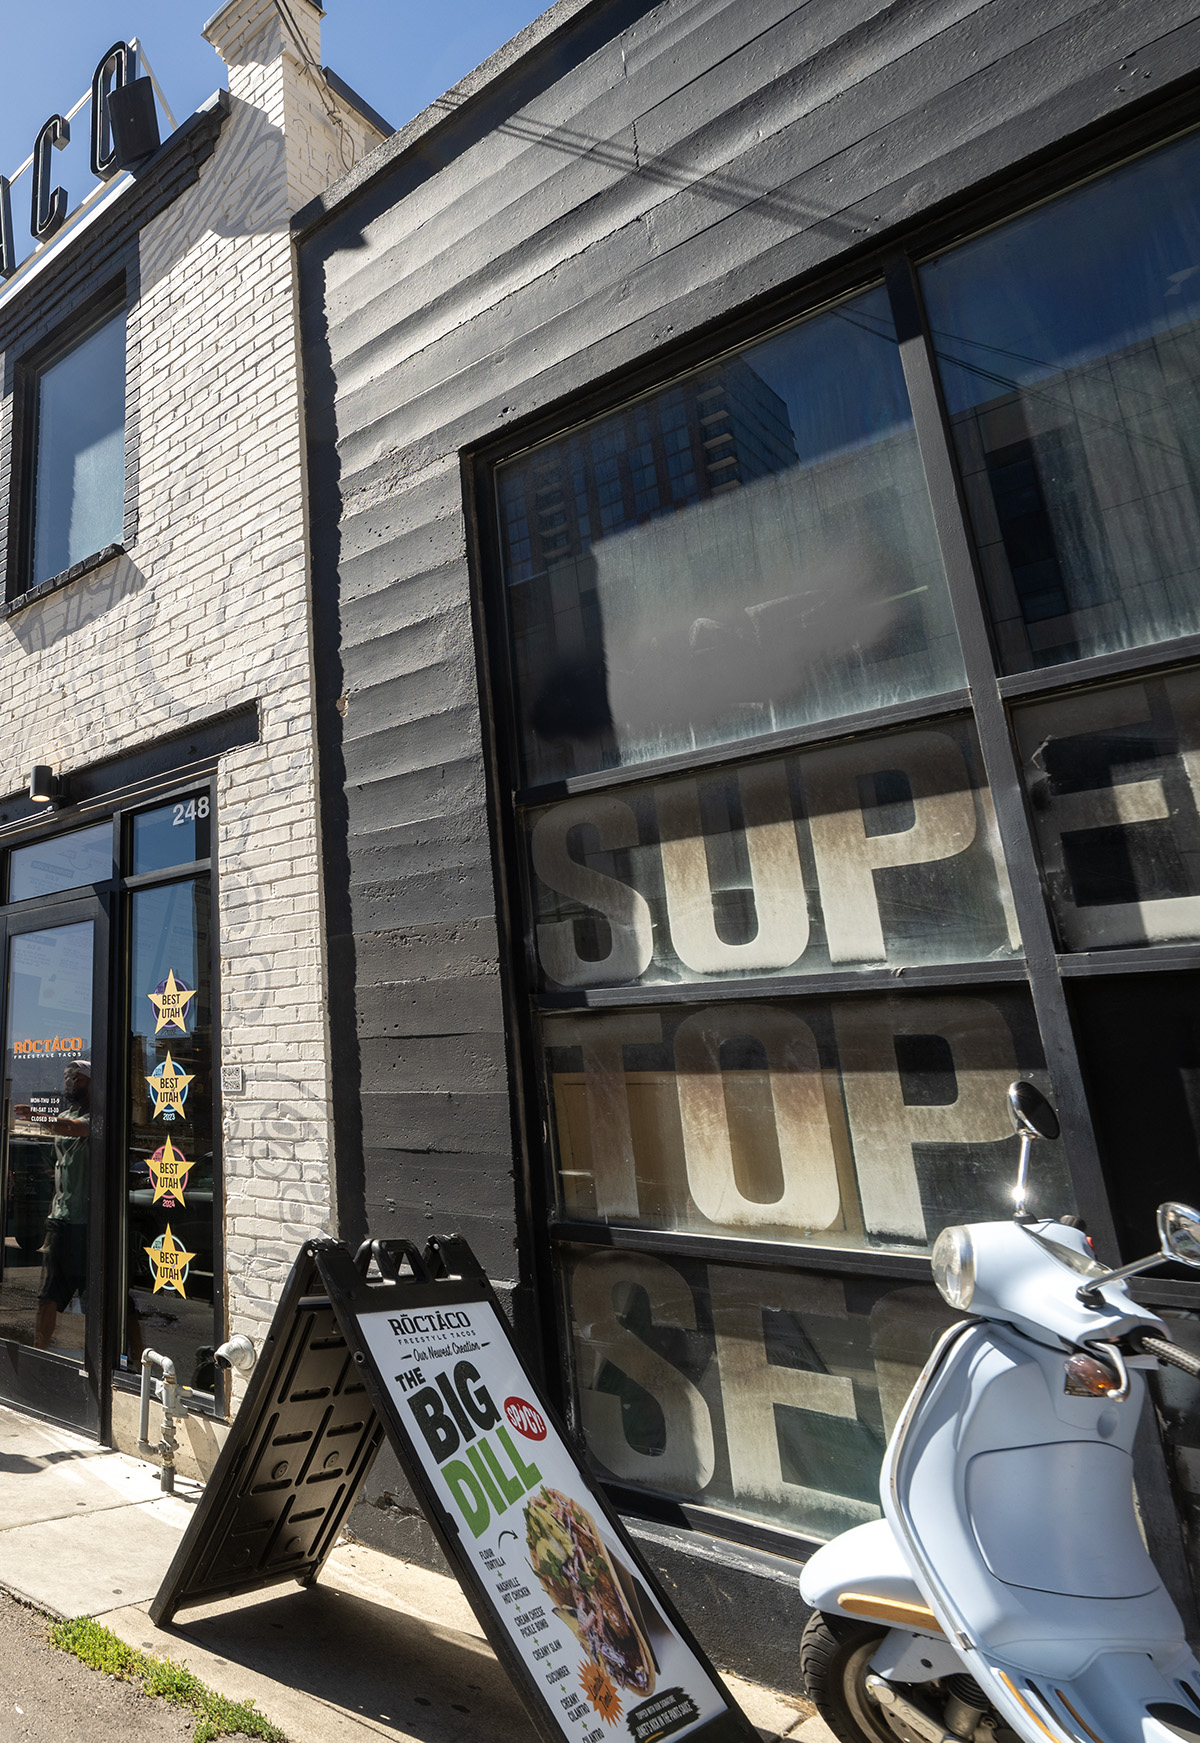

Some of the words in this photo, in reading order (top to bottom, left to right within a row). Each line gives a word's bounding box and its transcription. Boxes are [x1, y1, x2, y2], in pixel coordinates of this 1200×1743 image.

[172, 796, 210, 826] 248
[162, 994, 181, 1006] BEST
[161, 1007, 180, 1019] UTAH
[160, 1077, 179, 1089] BEST
[160, 1091, 179, 1103] UTAH
[163, 1113, 176, 1121] 2023
[545, 1000, 1022, 1248] TOP
[160, 1162, 179, 1175] BEST
[160, 1176, 179, 1189] UTAH
[160, 1251, 179, 1265] BEST
[160, 1266, 179, 1281] UTAH
[398, 1334, 448, 1345] FREESTYLE
[450, 1330, 477, 1339] TACOS
[413, 1348, 429, 1362] Our
[427, 1344, 453, 1359] Newest
[451, 1340, 481, 1355] Creation
[394, 1367, 426, 1392] THE
[406, 1360, 502, 1465] BIG
[506, 1402, 545, 1436] SPICY!
[440, 1424, 543, 1539] DILL
[479, 1547, 495, 1560] FLOUR
[484, 1556, 506, 1571] TORTILLA
[496, 1576, 521, 1593] NASHVILLE
[501, 1592, 513, 1605] HOT
[510, 1586, 531, 1601] CHICKEN
[513, 1612, 531, 1627] CREAM
[528, 1605, 546, 1620] CHEESE
[520, 1623, 538, 1638] PICKLE
[532, 1644, 552, 1661] CREAMY
[560, 1692, 580, 1710] CREAMY
